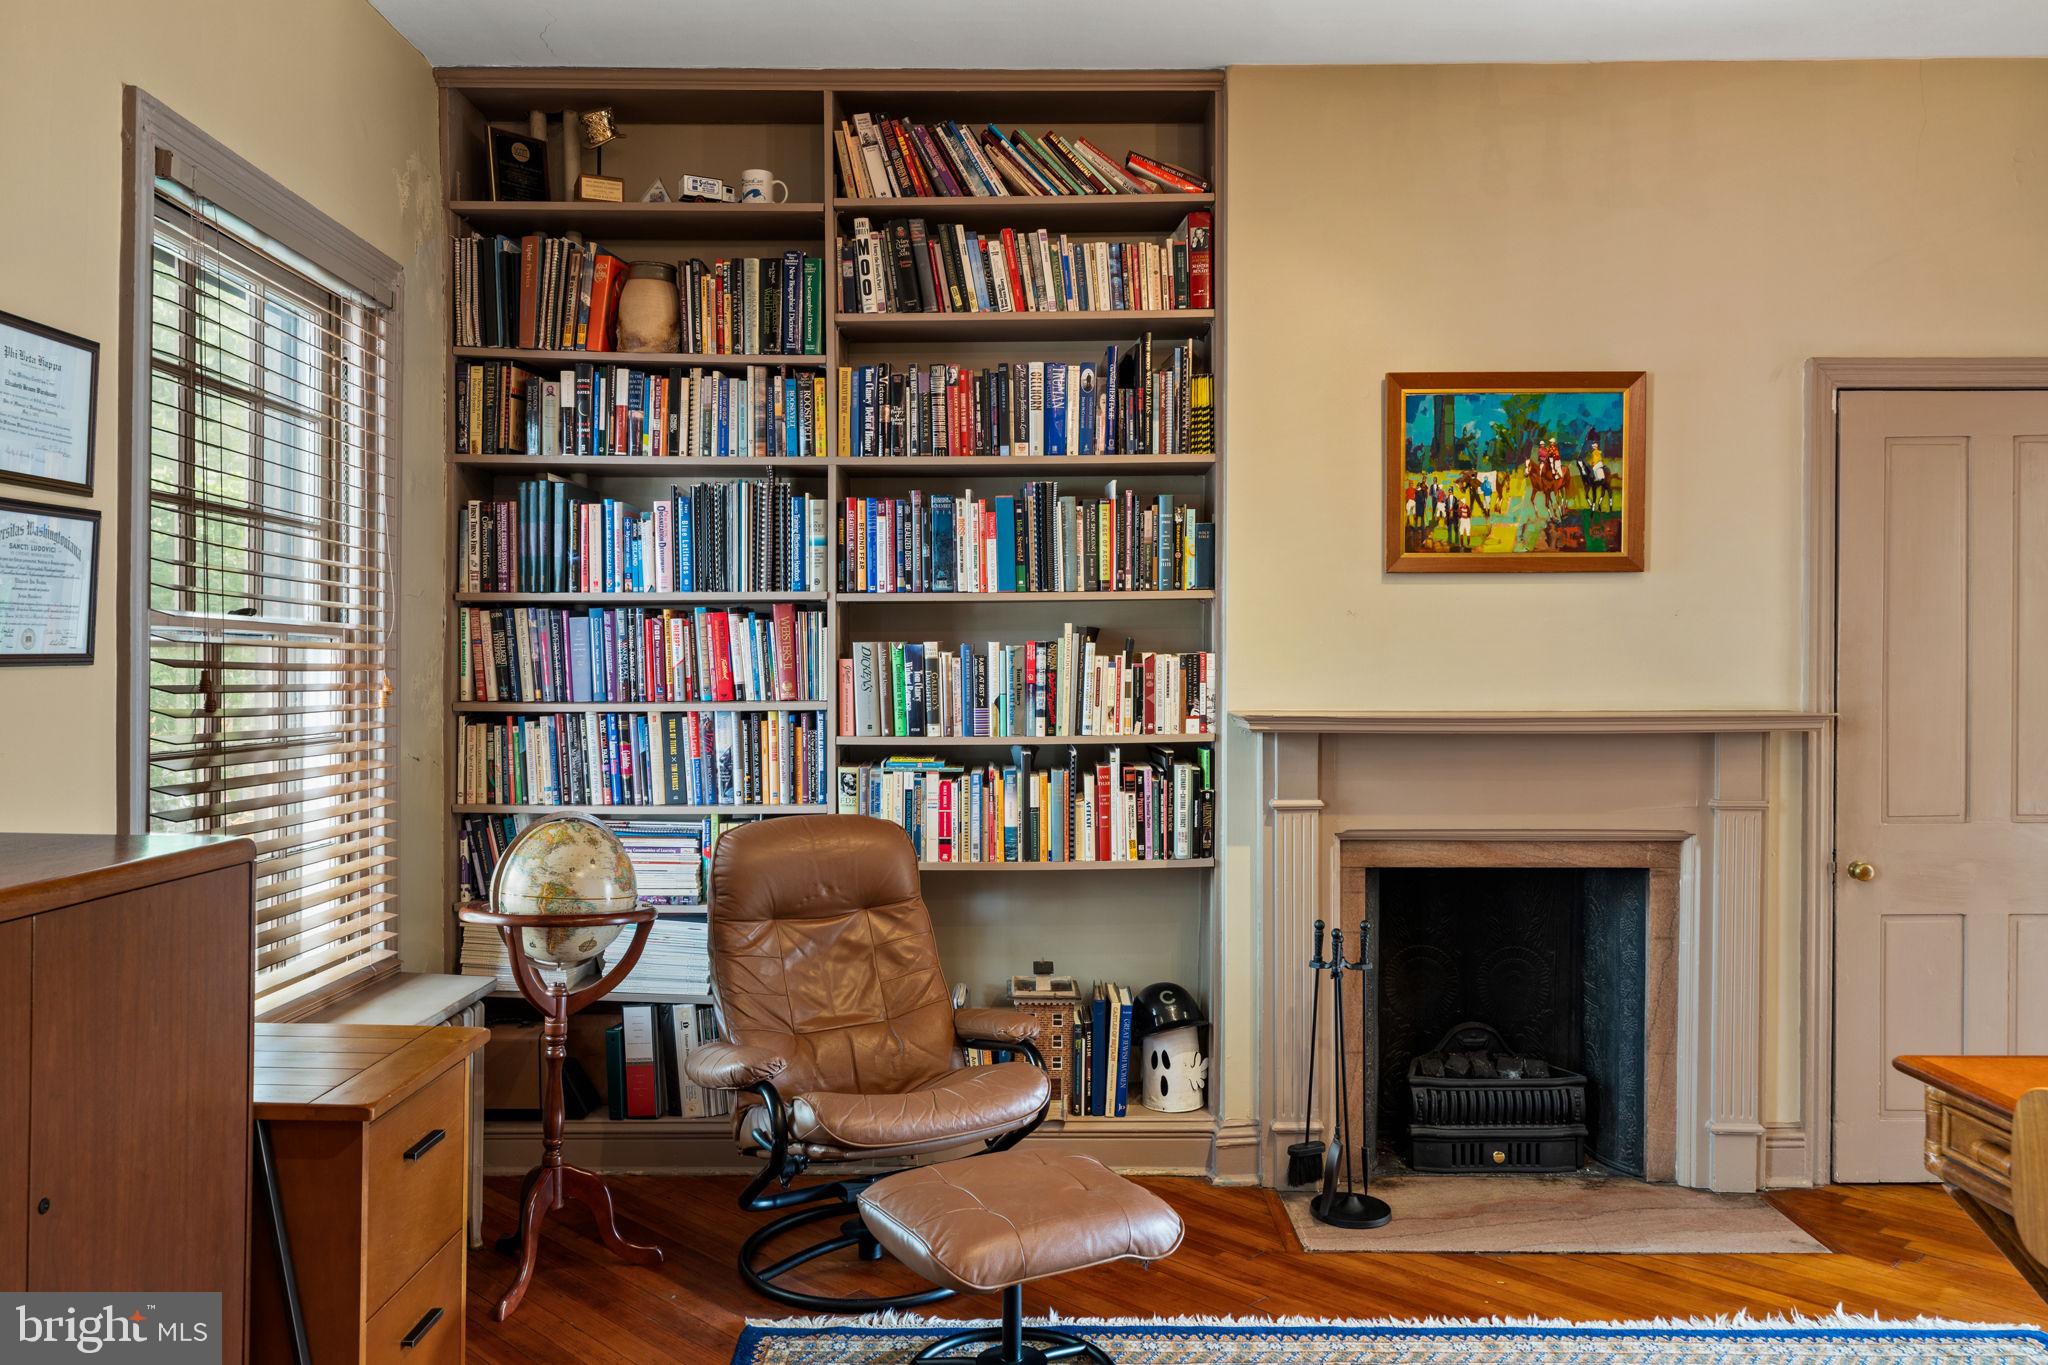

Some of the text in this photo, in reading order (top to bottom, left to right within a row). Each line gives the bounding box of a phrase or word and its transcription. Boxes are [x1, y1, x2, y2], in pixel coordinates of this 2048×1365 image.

[857, 238, 872, 296] MOO
[872, 243, 882, 278] Henry Fourth,
[787, 267, 796, 343] New Biographical Dictionary
[805, 286, 813, 317] Geographical
[805, 317, 813, 342] Dictionary
[3, 345, 62, 373] Phi Beta Kappa
[878, 375, 889, 405] Victors
[1030, 371, 1042, 411] GELLHORN
[1052, 367, 1065, 409] TRUMAN
[803, 390, 813, 442] ROOSEVELT
[862, 367, 875, 452] Tom Clancy Debt of Honor
[1016, 368, 1027, 441] The Adams-Jefferson Letters
[470, 504, 478, 556] FIRST THINGS FIRST
[500, 504, 508, 529] INNOVATIVE
[793, 514, 801, 533] Training
[9, 542, 57, 554] SANCTI LUDOVICI
[481, 516, 490, 579] COMPENSATION HANDBOOK
[657, 506, 667, 573] ORGANIZATION DEVELOPMENT
[793, 534, 801, 560] Effectiveness
[1016, 536, 1024, 562] Scratch!
[682, 539, 690, 575] Latitudes
[493, 633, 501, 664] ENTERPRISE
[498, 631, 507, 664] INTELLIGENT
[673, 624, 681, 647] DILBERT
[780, 615, 794, 661] WEBSTER'S
[860, 646, 873, 693] DICKENS
[1049, 643, 1057, 670] STEPHEN
[904, 661, 915, 711] Without Remorse
[912, 671, 923, 702] Tom Clancy
[931, 672, 940, 710] GALILEO'S
[979, 676, 985, 684] AT
[1015, 682, 1023, 706] Clancy
[690, 716, 698, 739] Michael
[703, 730, 715, 753] 1776
[669, 719, 680, 791] TOOLS TITANS TIM FERRISS
[840, 796, 857, 804] FDR
[1159, 990, 1176, 1005] C
[1122, 1018, 1131, 1039] GREAT
[1121, 1040, 1129, 1062] JEWISH
